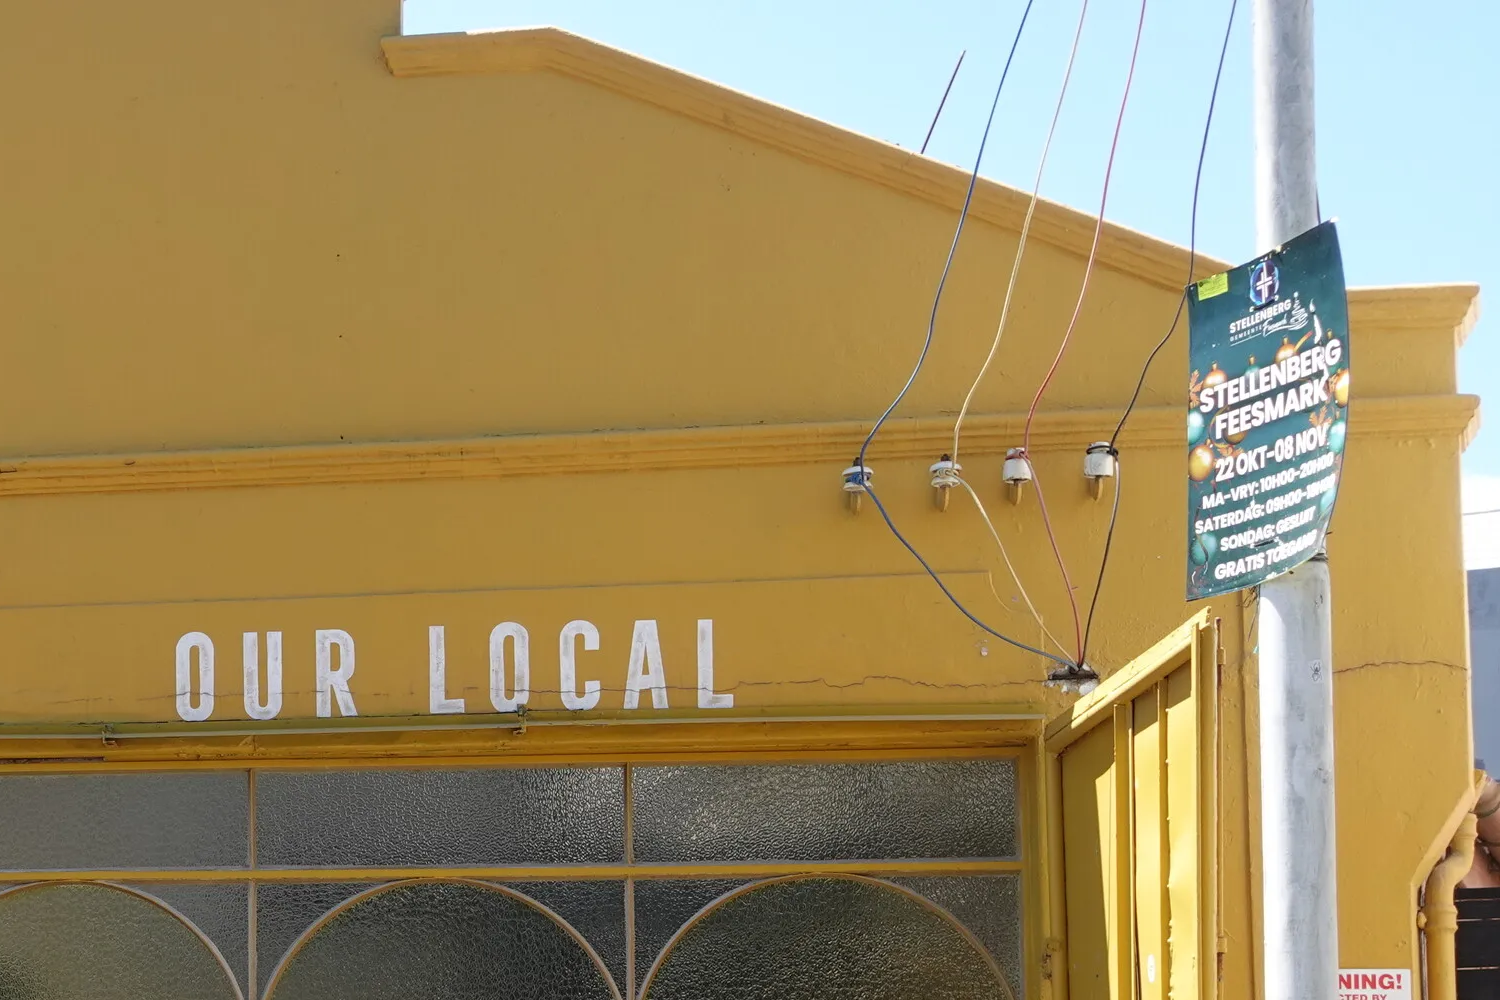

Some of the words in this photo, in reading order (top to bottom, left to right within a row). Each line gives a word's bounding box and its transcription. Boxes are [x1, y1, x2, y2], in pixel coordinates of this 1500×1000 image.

[1229, 299, 1292, 334] STELLENBERG
[1200, 338, 1342, 413] STELLENBERG
[1215, 378, 1328, 440] FEESMARK
[1215, 456, 1235, 482] 22
[1235, 439, 1294, 476] OKT-08
[1202, 481, 1260, 509] MA-VRY:
[1195, 505, 1265, 534] SATERDAG:
[1220, 524, 1275, 551] SONDAG:
[1276, 506, 1316, 534] GESLUIT
[1214, 553, 1264, 580] GRATIS
[1266, 529, 1318, 566] TOEGANG
[175, 629, 358, 721] OUR
[429, 619, 734, 714] LOCAL
[1338, 974, 1402, 990] NING!
